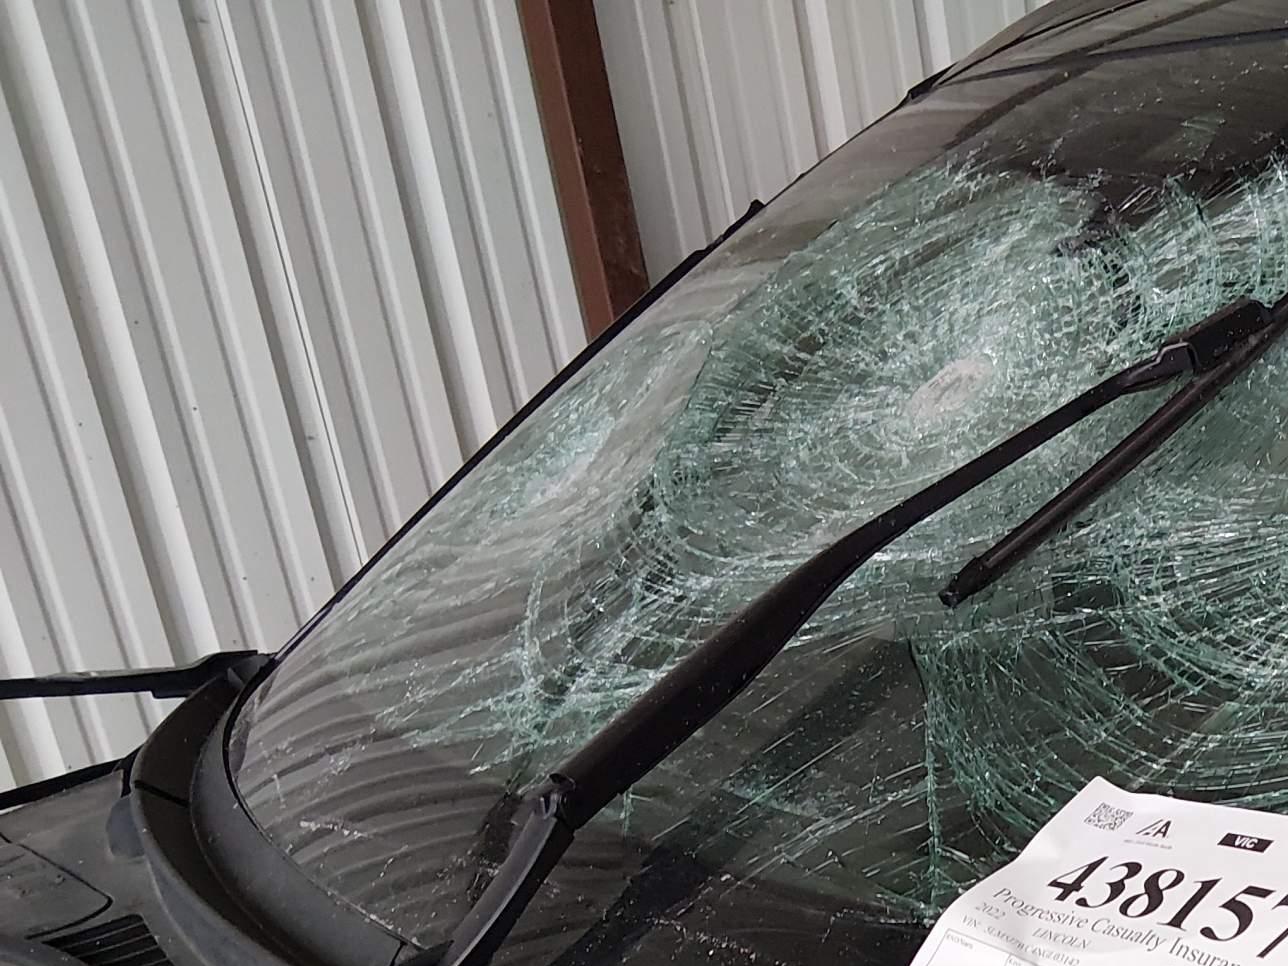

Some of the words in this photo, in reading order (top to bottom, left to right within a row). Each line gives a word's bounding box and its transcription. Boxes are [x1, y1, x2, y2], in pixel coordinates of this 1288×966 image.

[975, 901, 1007, 921] 2022
[1032, 926, 1092, 950] LINCOLN
[992, 886, 1087, 930] Progressive
[1090, 913, 1167, 952] Casualty
